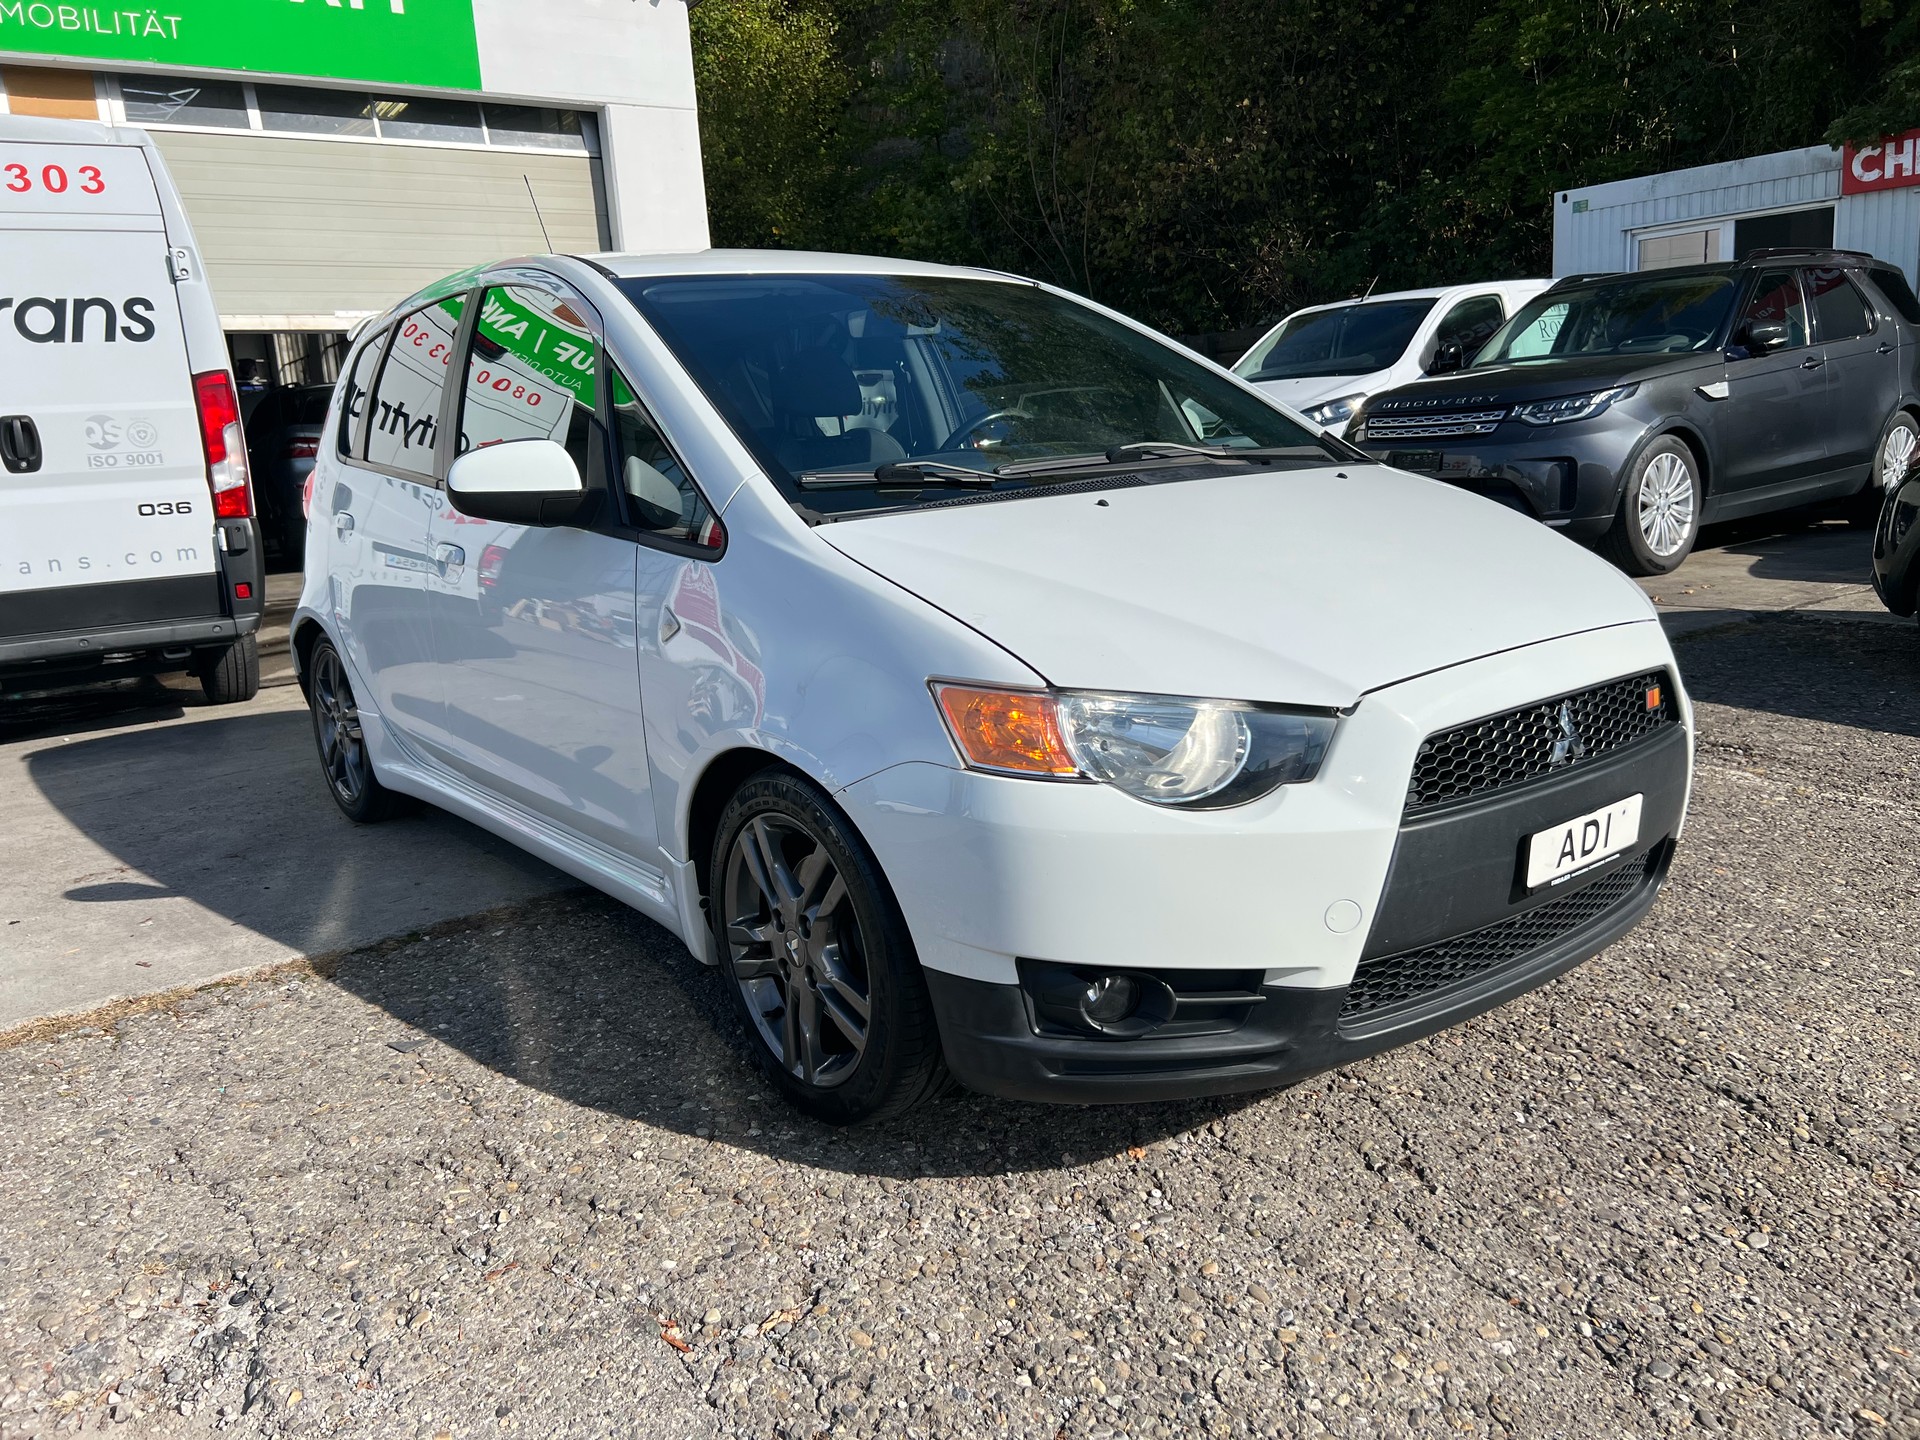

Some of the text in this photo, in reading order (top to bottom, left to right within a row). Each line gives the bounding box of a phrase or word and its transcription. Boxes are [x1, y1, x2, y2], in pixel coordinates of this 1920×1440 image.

[0, 2, 182, 40] MOBILITÄT
[4, 163, 105, 195] 303
[1382, 395, 1500, 409] DISCOVERY
[87, 453, 164, 468] ISO 9001
[0, 546, 198, 575] ans.com
[1556, 812, 1612, 869] ADI
